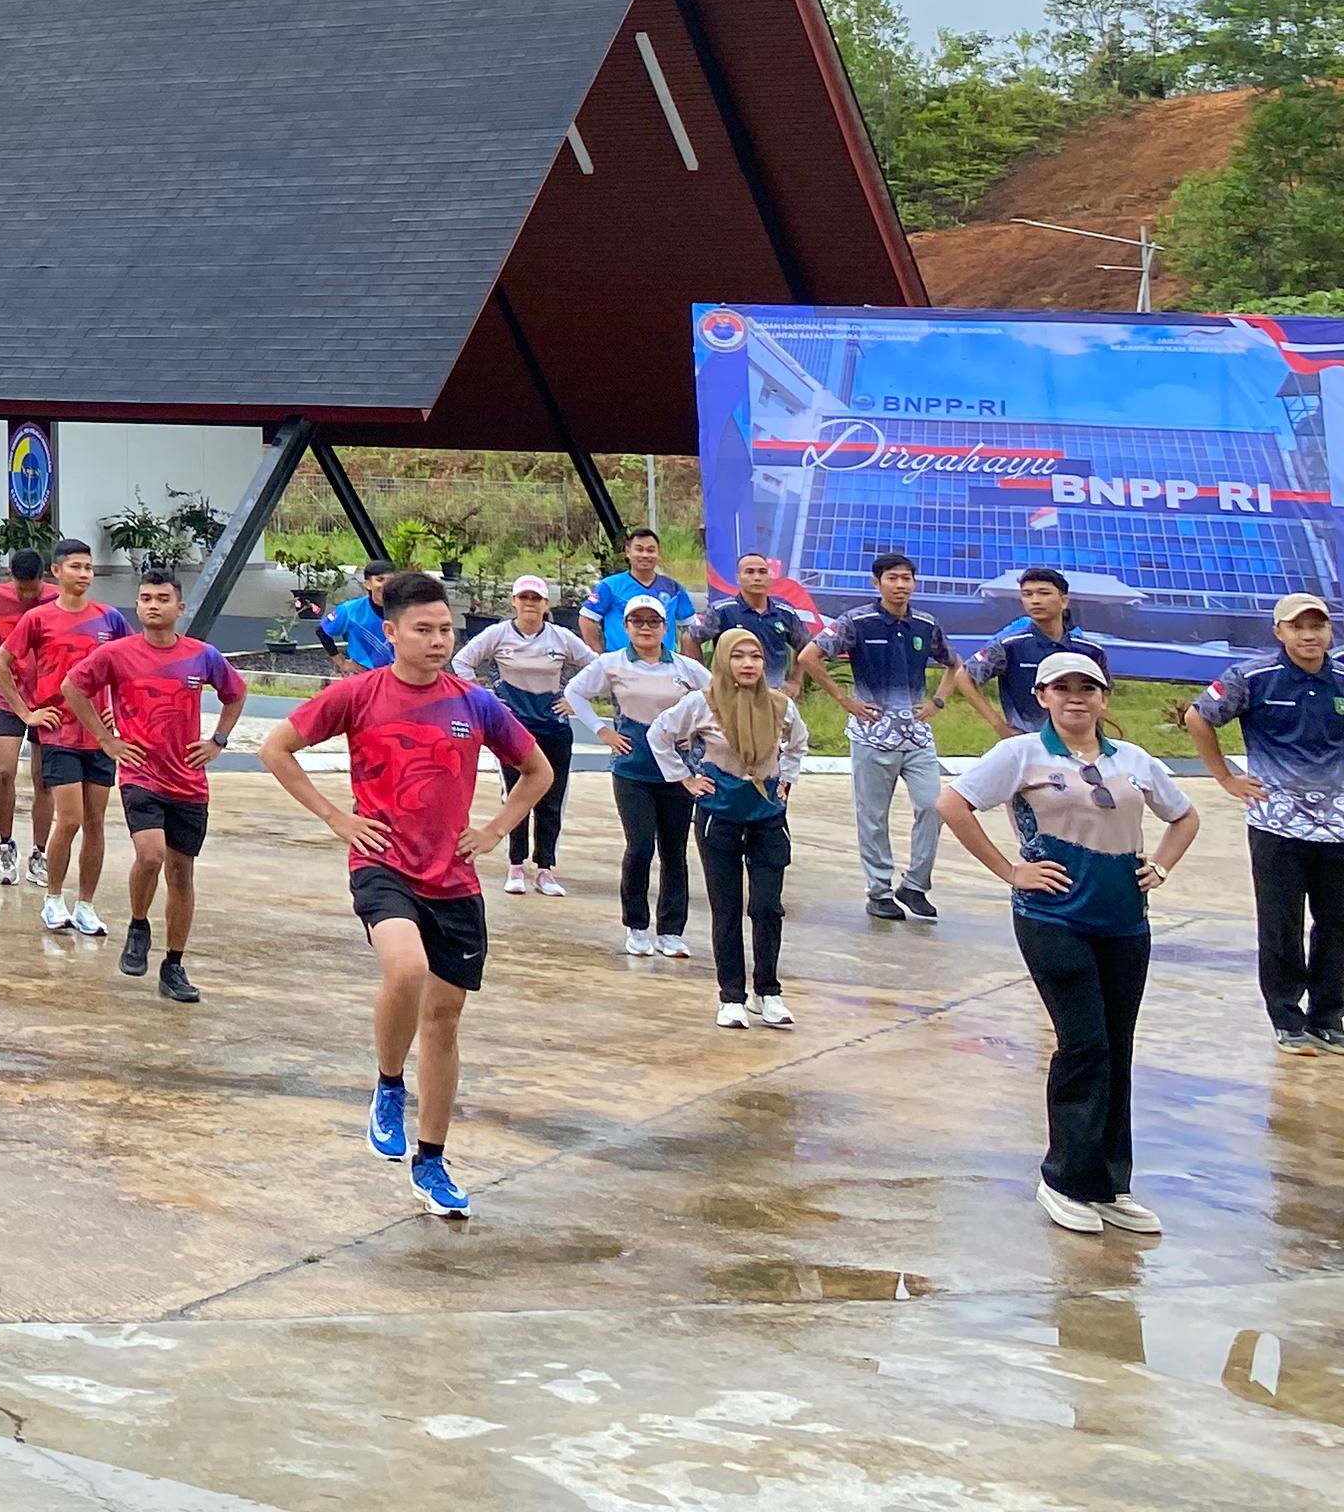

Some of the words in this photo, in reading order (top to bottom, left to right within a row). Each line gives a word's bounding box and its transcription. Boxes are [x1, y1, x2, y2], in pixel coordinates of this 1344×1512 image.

[883, 396, 1006, 416] BNPP-RI
[801, 418, 1058, 484] Dirgahayu
[1051, 474, 1198, 509] BNPP
[1218, 481, 1273, 513] RI
